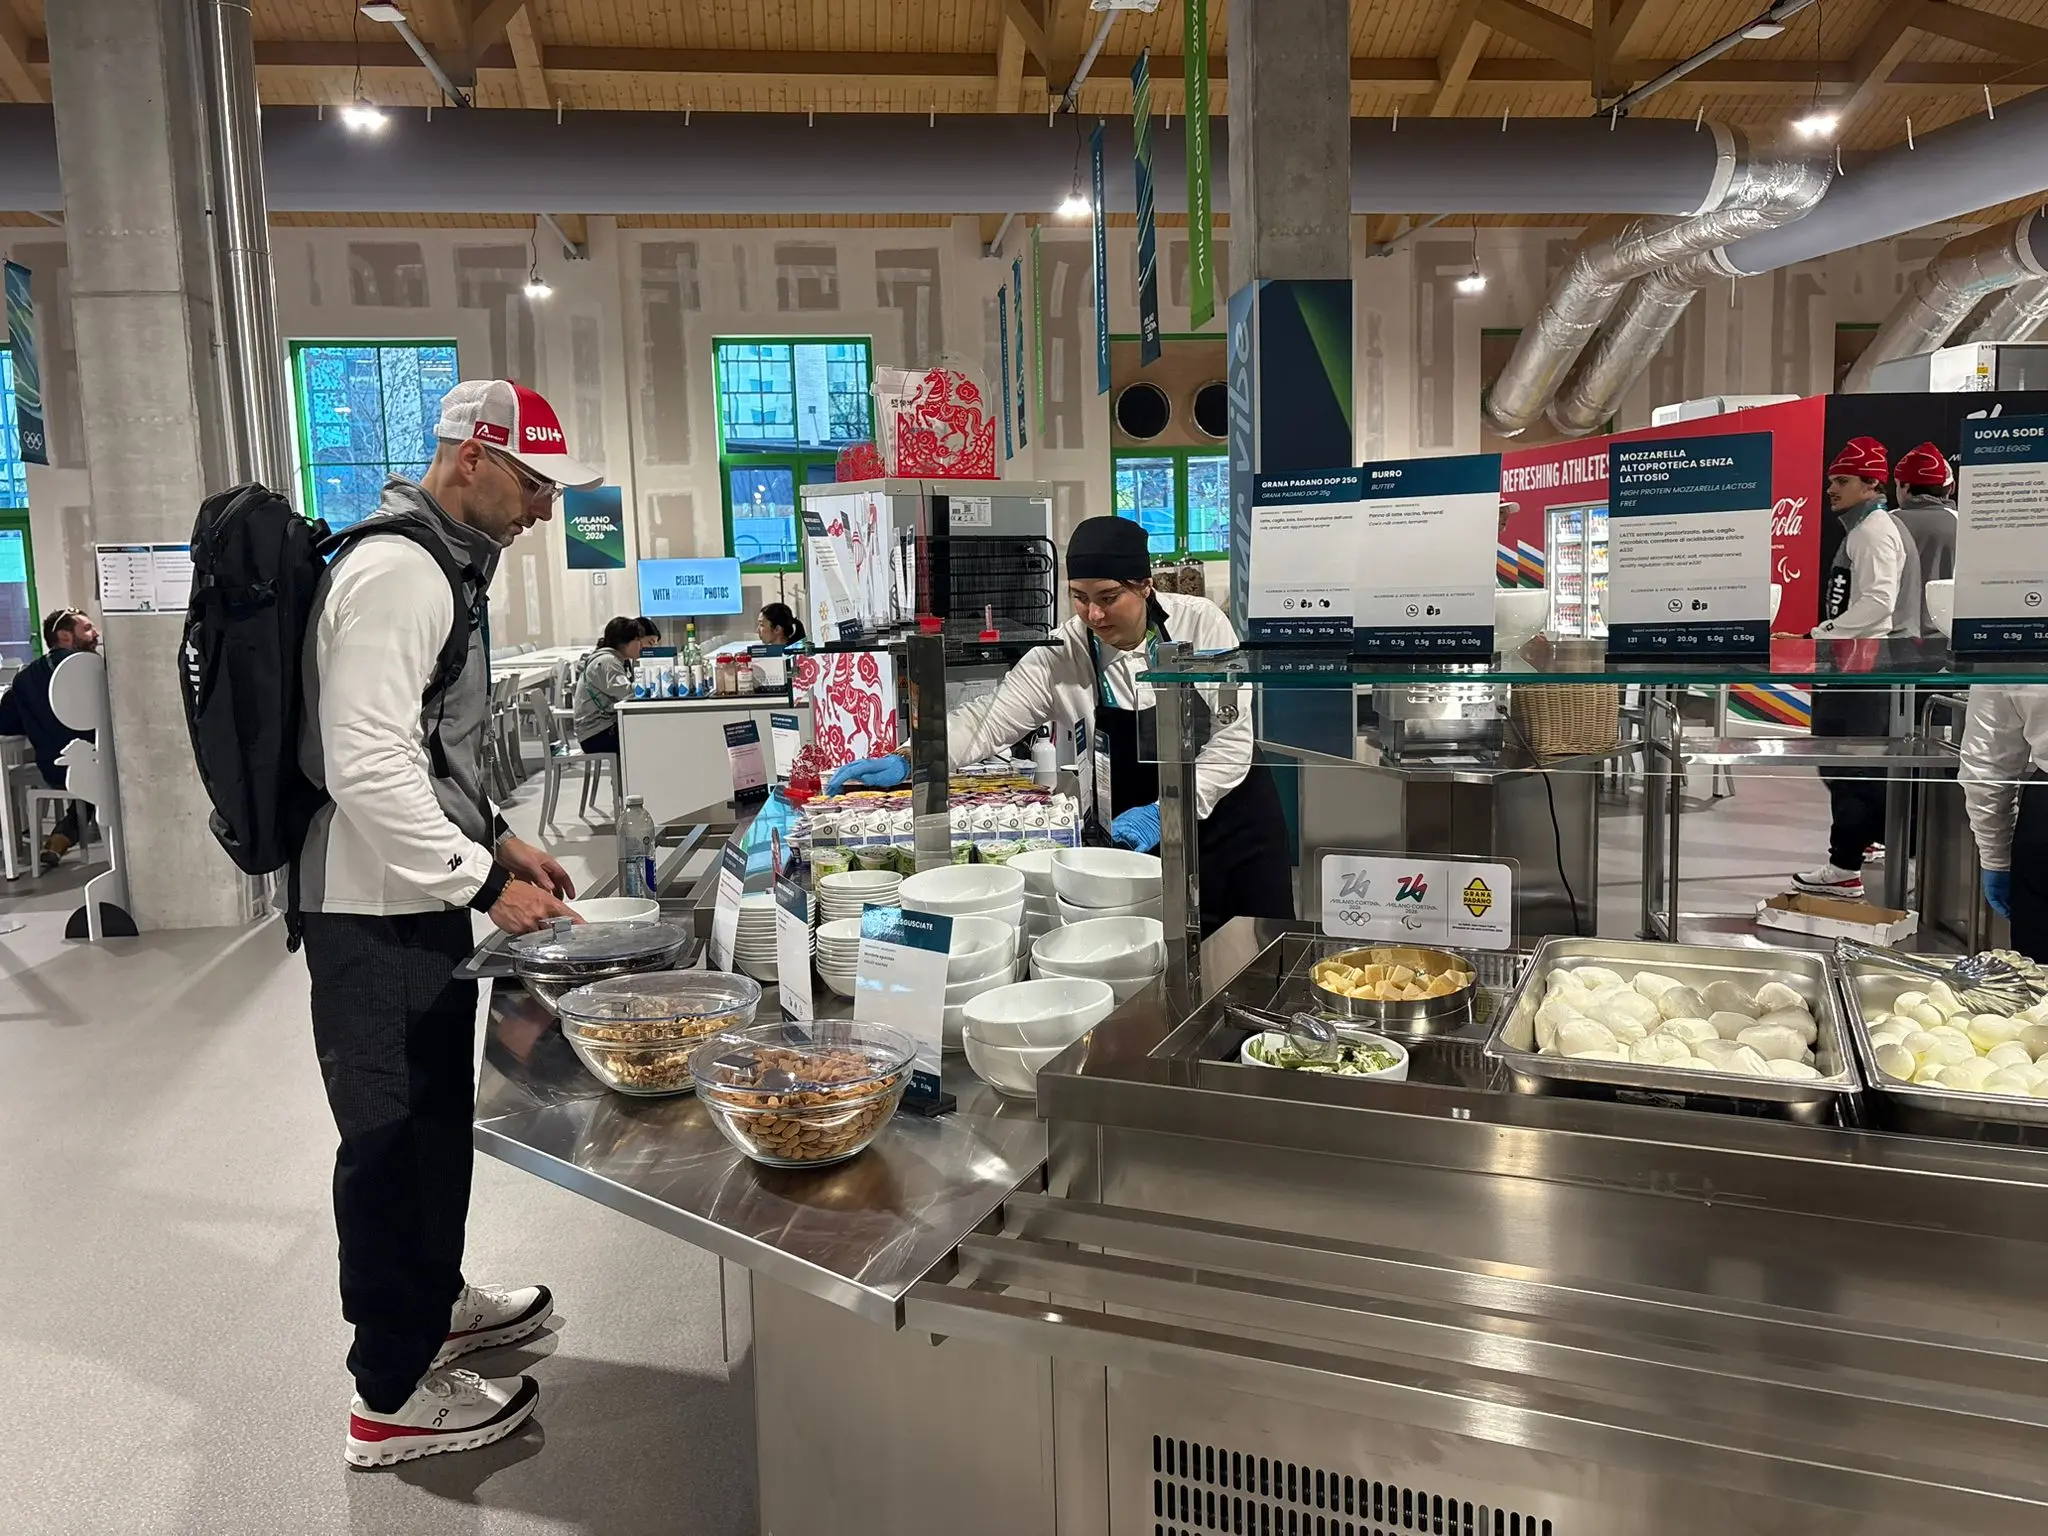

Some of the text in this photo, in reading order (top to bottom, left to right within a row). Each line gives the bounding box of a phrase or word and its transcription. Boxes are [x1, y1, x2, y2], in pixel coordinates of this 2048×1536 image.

[1196, 178, 1205, 287] MILANO
[1974, 427, 2045, 439] UOVA SODE
[1973, 444, 2032, 454] BOILED EGGS
[1619, 449, 1687, 462] MOZZARELLA
[1619, 457, 1734, 473] ALTOPROTEICA SENZA
[1372, 469, 1402, 478] BURRO
[1503, 462, 1560, 493] REFRESHING
[1619, 472, 1670, 484] LATTOSIO
[1290, 478, 1323, 487] PADANO
[1324, 477, 1341, 485] DOP
[1341, 476, 1358, 484] 25G
[1371, 483, 1395, 491] BUTTER
[1619, 481, 1758, 497] HIGH PROTEIN MOZZARELLA LACTOSE
[1619, 499, 1637, 507] FREE
[570, 515, 610, 524] MILANO
[577, 524, 618, 532] CORTINA
[585, 532, 605, 540] 2026
[675, 575, 704, 586] CELEBRATE
[652, 588, 671, 601] WITH
[704, 586, 729, 600] PHOTOS
[1652, 636, 1667, 645] 1.4g
[1677, 635, 1698, 644] 20.0g
[1707, 635, 1724, 643] 5.0g
[1733, 634, 1755, 642] 0.50g
[900, 918, 934, 931] SGUSCIATE
